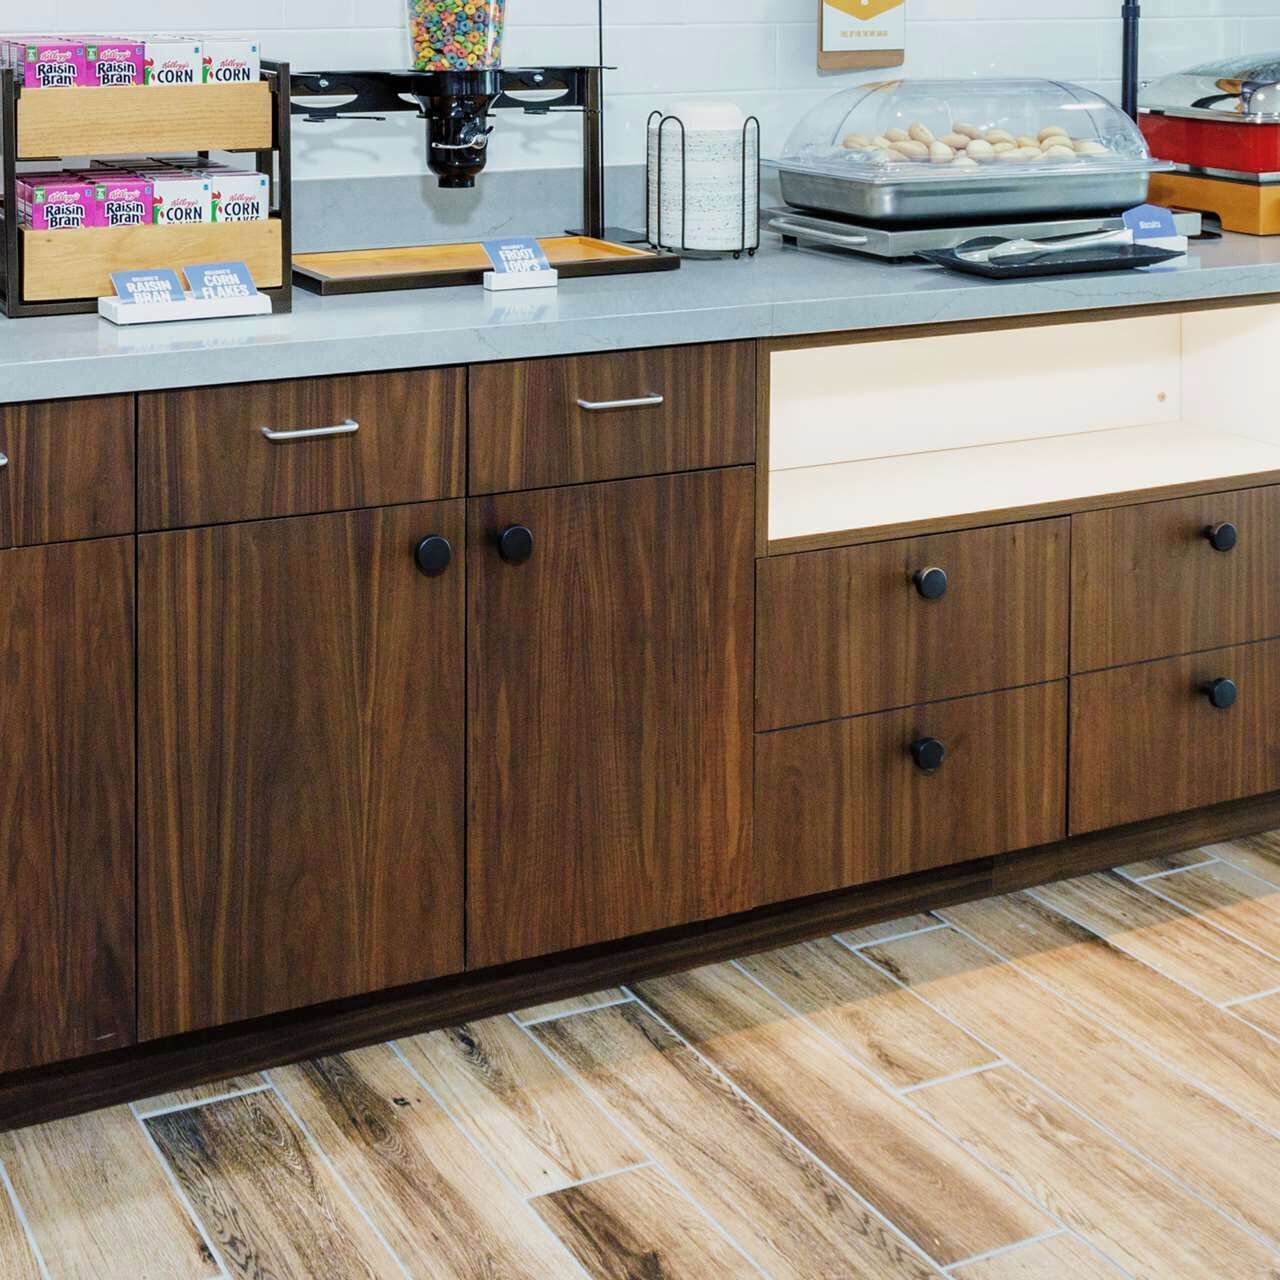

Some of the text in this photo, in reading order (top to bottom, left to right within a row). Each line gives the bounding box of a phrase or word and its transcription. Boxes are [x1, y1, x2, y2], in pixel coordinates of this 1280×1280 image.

[37, 63, 76, 76] Raisin
[97, 62, 135, 75] Raisin
[215, 68, 251, 82] CORN
[42, 74, 72, 86] Bran
[102, 74, 131, 85] Bran
[157, 69, 193, 83] CORN
[45, 205, 84, 218] Raisin
[106, 202, 144, 215] Raisin
[166, 206, 202, 221] CORN
[224, 202, 260, 216] CORN
[50, 216, 80, 228] Bran
[111, 214, 140, 225] Bran
[499, 248, 535, 261] FROOT
[126, 280, 172, 292] RAISIN
[203, 273, 240, 286] CORN
[133, 291, 172, 304] BRAN
[201, 284, 250, 299] FLAKES
